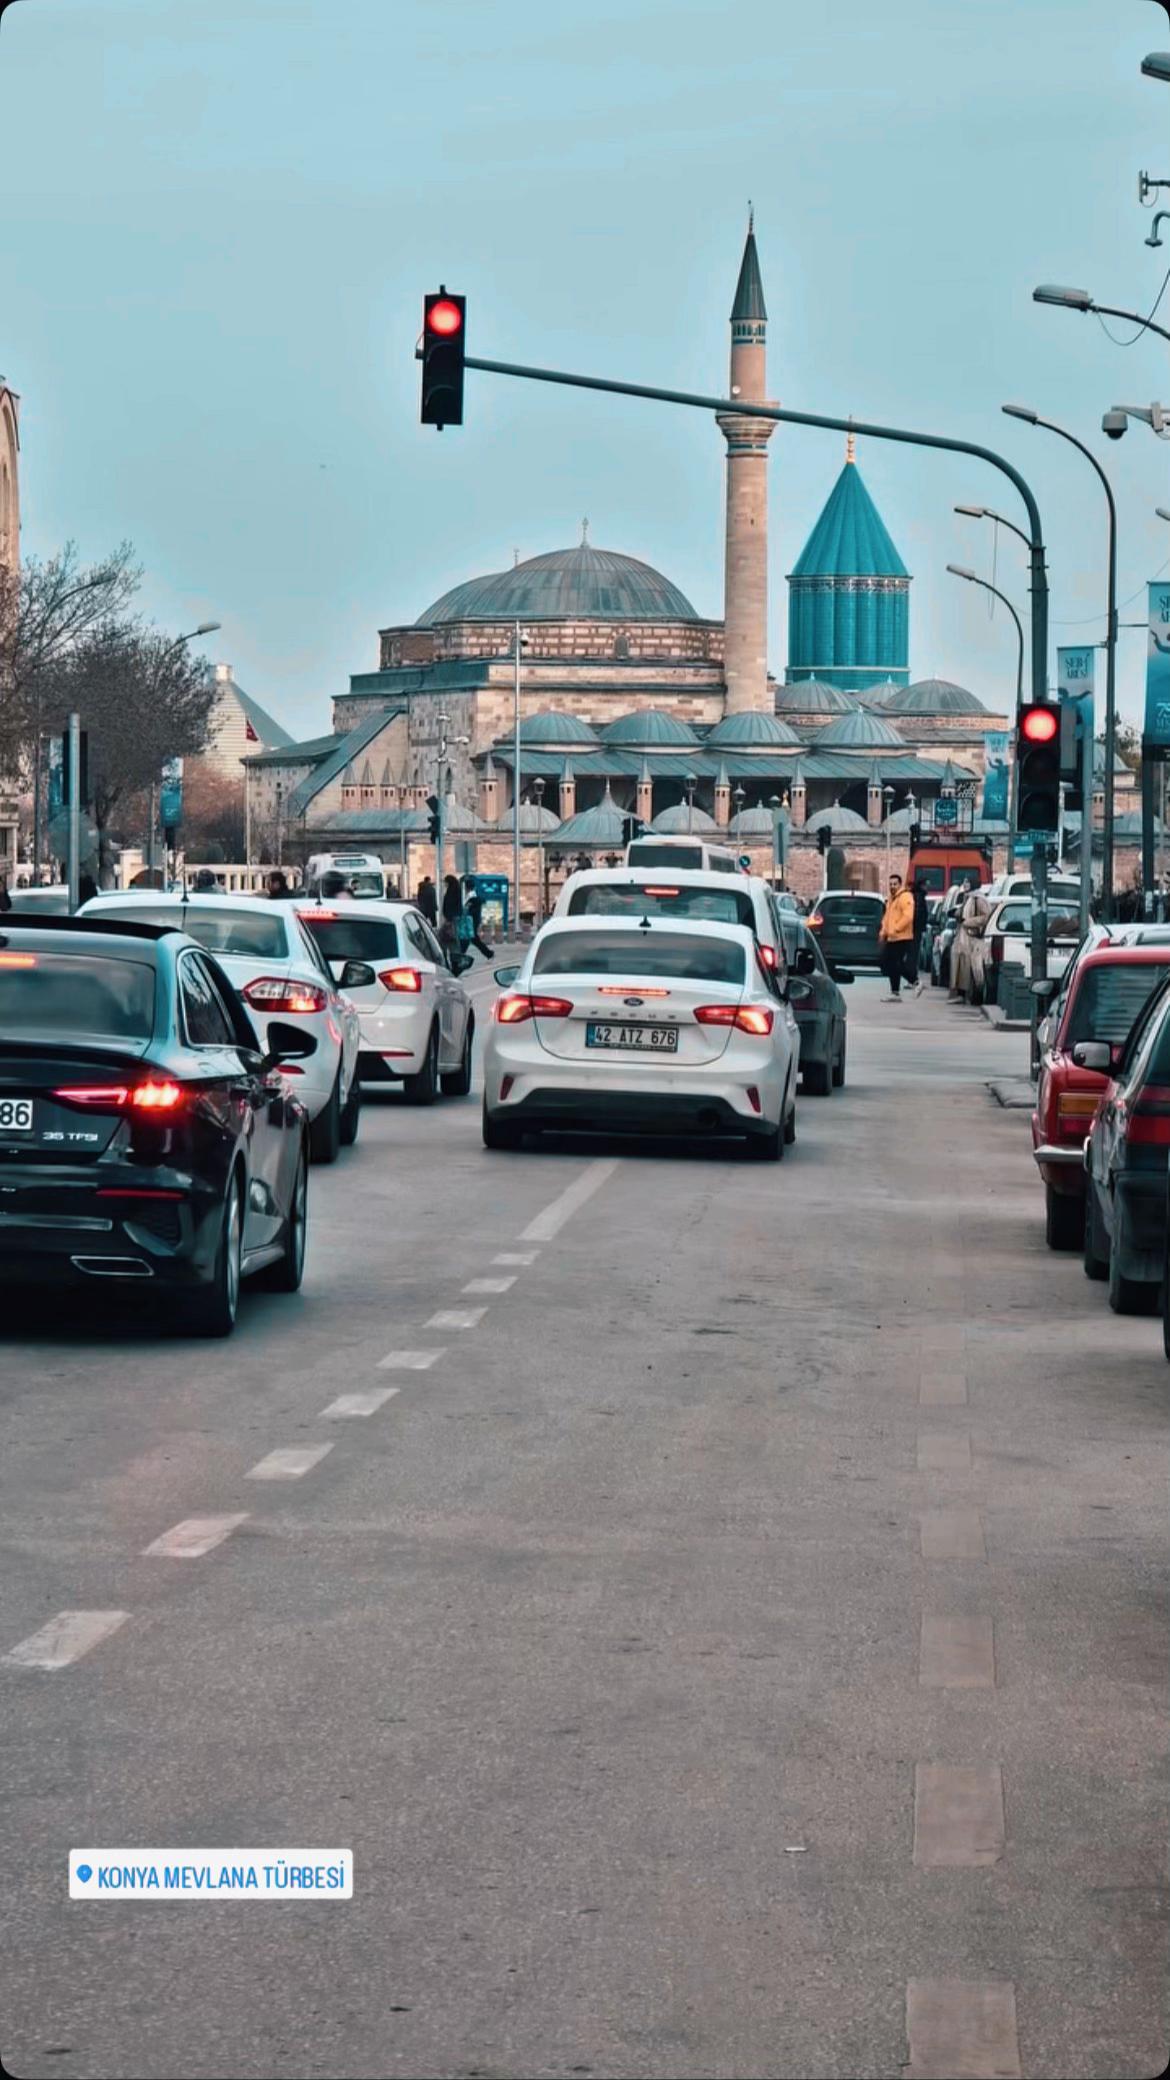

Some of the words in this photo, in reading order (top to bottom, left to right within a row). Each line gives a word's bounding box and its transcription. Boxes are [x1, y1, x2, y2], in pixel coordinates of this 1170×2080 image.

[595, 1027, 612, 1042] 42
[620, 1028, 643, 1044] ATZ
[651, 1030, 675, 1045] 676
[0, 1102, 30, 1126] 86
[67, 1132, 98, 1142] TFSI
